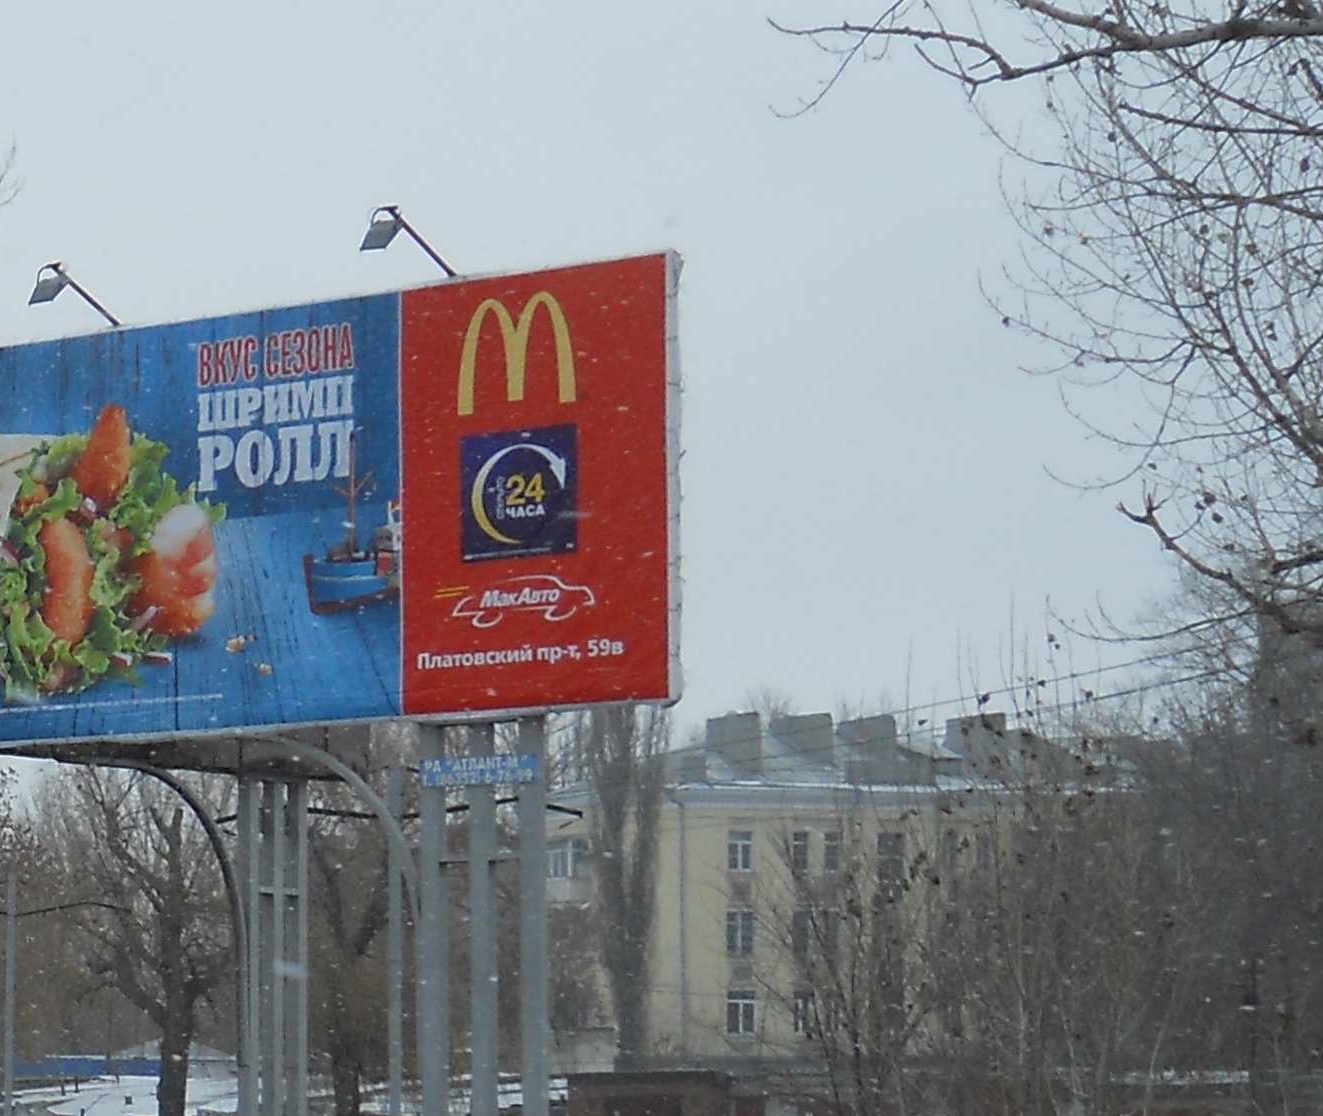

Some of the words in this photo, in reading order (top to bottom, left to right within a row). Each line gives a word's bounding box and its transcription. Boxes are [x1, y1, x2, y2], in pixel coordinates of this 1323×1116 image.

[198, 335, 257, 388] ВКУС
[264, 322, 354, 379] СЕЗОНА
[197, 375, 354, 432] ШРИМП
[197, 419, 354, 492] РОЛЛ
[506, 473, 546, 506] 24
[506, 504, 545, 518] ЧАСА
[480, 587, 560, 608] МакАвто
[417, 645, 533, 670] Платовский
[537, 645, 581, 664] пр-т,
[588, 639, 624, 657] 59в
